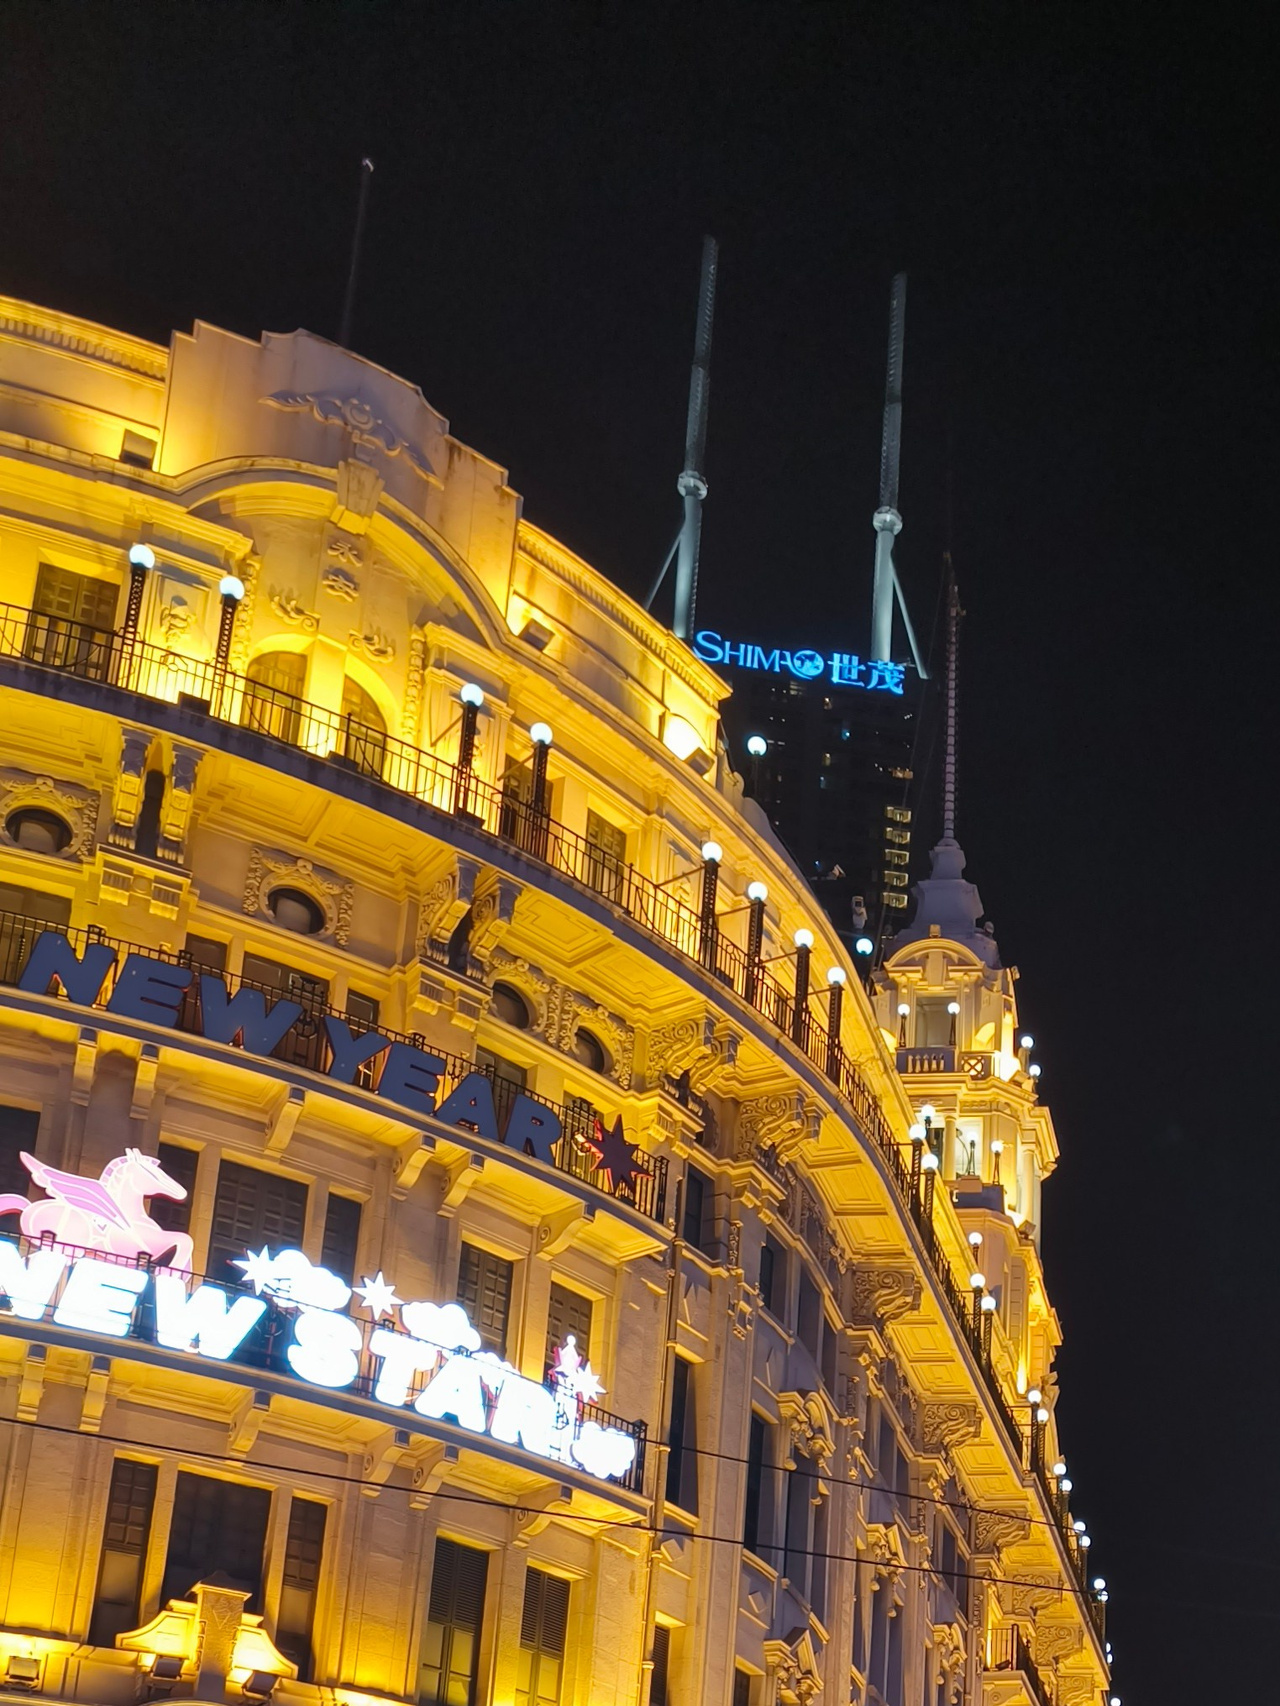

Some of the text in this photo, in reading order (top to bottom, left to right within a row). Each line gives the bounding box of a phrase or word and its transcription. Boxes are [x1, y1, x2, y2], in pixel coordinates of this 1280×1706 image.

[827, 652, 906, 694] 世茂
[18, 930, 563, 1166] NEW YEAR
[0, 1238, 267, 1360] NEW
